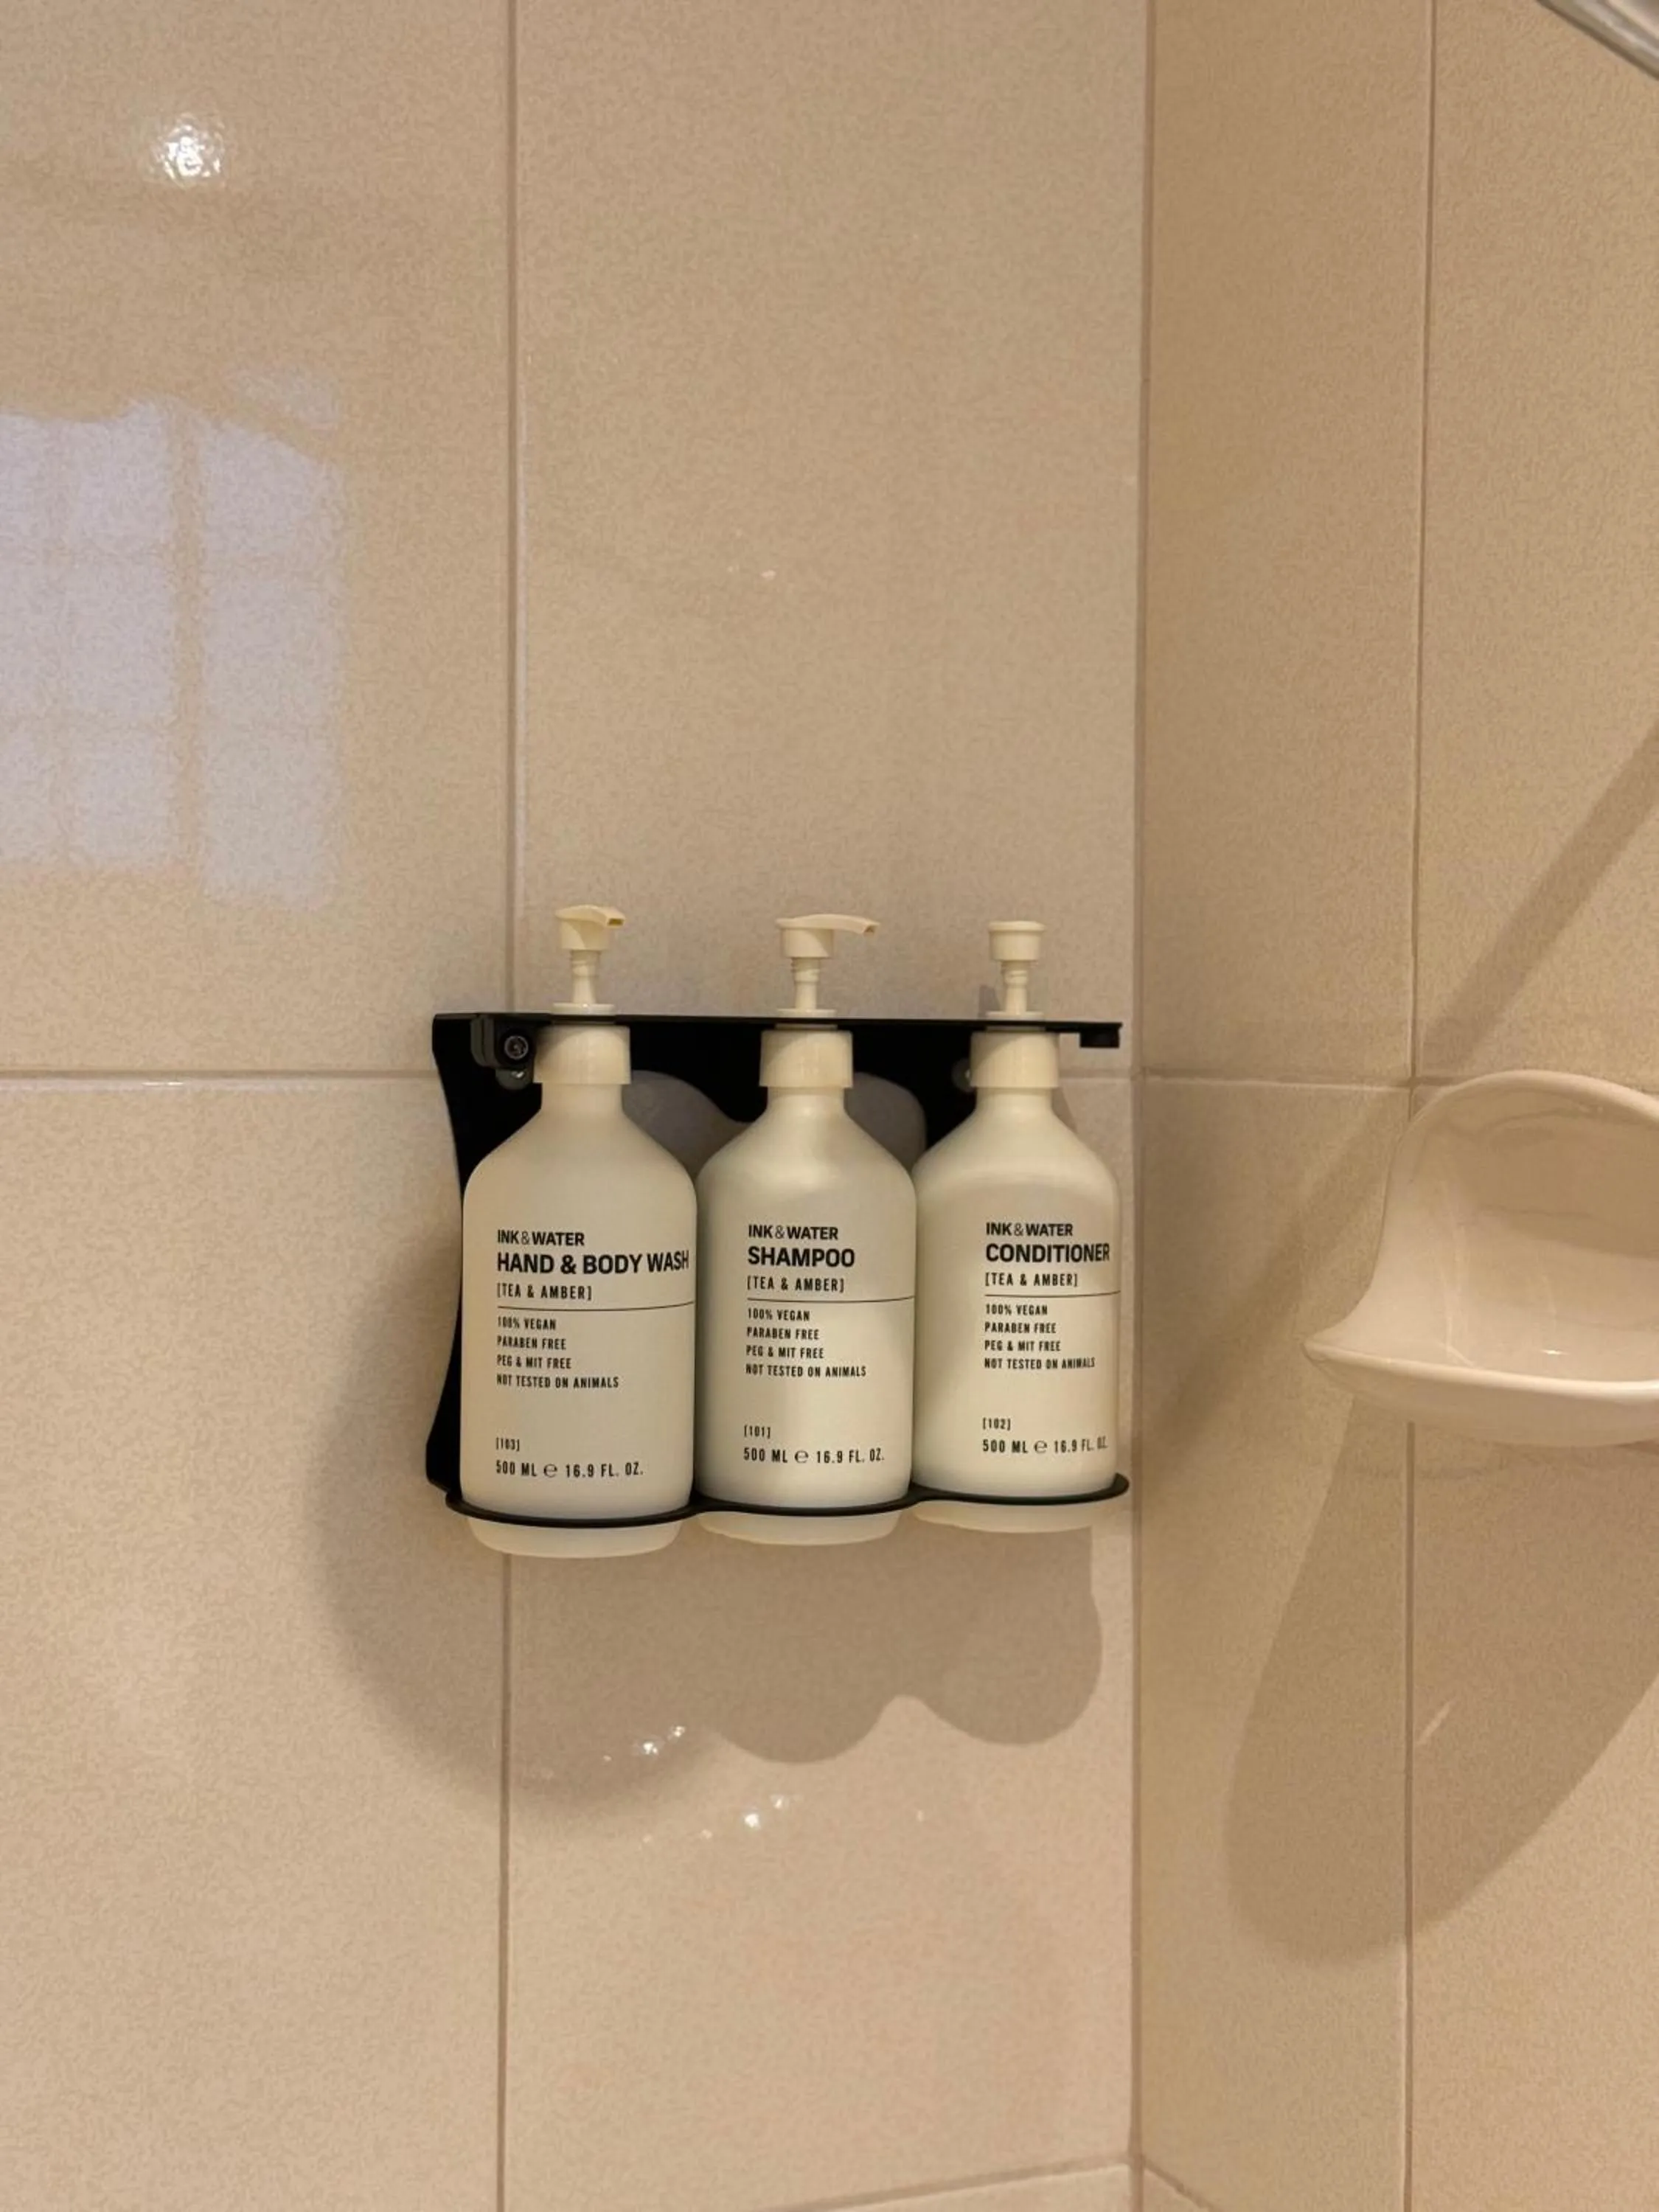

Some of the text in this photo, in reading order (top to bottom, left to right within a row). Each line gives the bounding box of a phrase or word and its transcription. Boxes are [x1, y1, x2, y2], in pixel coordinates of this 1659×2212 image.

[748, 1224, 838, 1240] INK&WATER
[987, 1222, 1073, 1237] INK&WATER
[498, 1230, 585, 1246] INK&WATER
[748, 1246, 855, 1267] SHAMPOO
[986, 1243, 1110, 1263] CONDITIONER
[498, 1251, 689, 1274] HAND & BODY WASH
[748, 1276, 844, 1293] [TEA & AMBER]
[985, 1272, 1077, 1287] [TEA & AMBER]
[497, 1282, 591, 1301] [TEA & AMBER]
[748, 1308, 810, 1321] 100% VEGAN
[986, 1304, 1047, 1315] 100% VEGAN
[498, 1316, 556, 1330] 100% VEGAN
[985, 1321, 1056, 1334] PARABEN FREE
[747, 1326, 819, 1340] PARABEN FREE
[497, 1335, 566, 1350] PARABEN FREE
[984, 1340, 1060, 1352] PEG & MIT FREE
[746, 1345, 824, 1359] PEG & MIT FREE
[496, 1354, 571, 1369] PEG & MIT FREE
[984, 1357, 1095, 1370] NOT TESTED ON ANIMALS
[746, 1364, 866, 1377] NOT TESTED ON ANIMALS
[497, 1373, 619, 1388] NOT TESTED ON ANIMALS
[983, 1417, 1011, 1431] [102]
[744, 1425, 771, 1439] [101]
[983, 1439, 1006, 1453] 500
[1012, 1440, 1028, 1453] ML
[1054, 1439, 1077, 1453] 16.9
[1081, 1439, 1093, 1452] FL.
[744, 1447, 765, 1462] 500
[771, 1449, 787, 1463] ML
[816, 1450, 843, 1464] 16.9
[849, 1449, 864, 1463] FL.
[869, 1448, 884, 1462] OZ.
[496, 1460, 515, 1475] 500
[521, 1463, 537, 1477] ML
[566, 1464, 594, 1478] 16.9
[601, 1463, 619, 1478] FL.
[625, 1461, 643, 1476] OZ.
